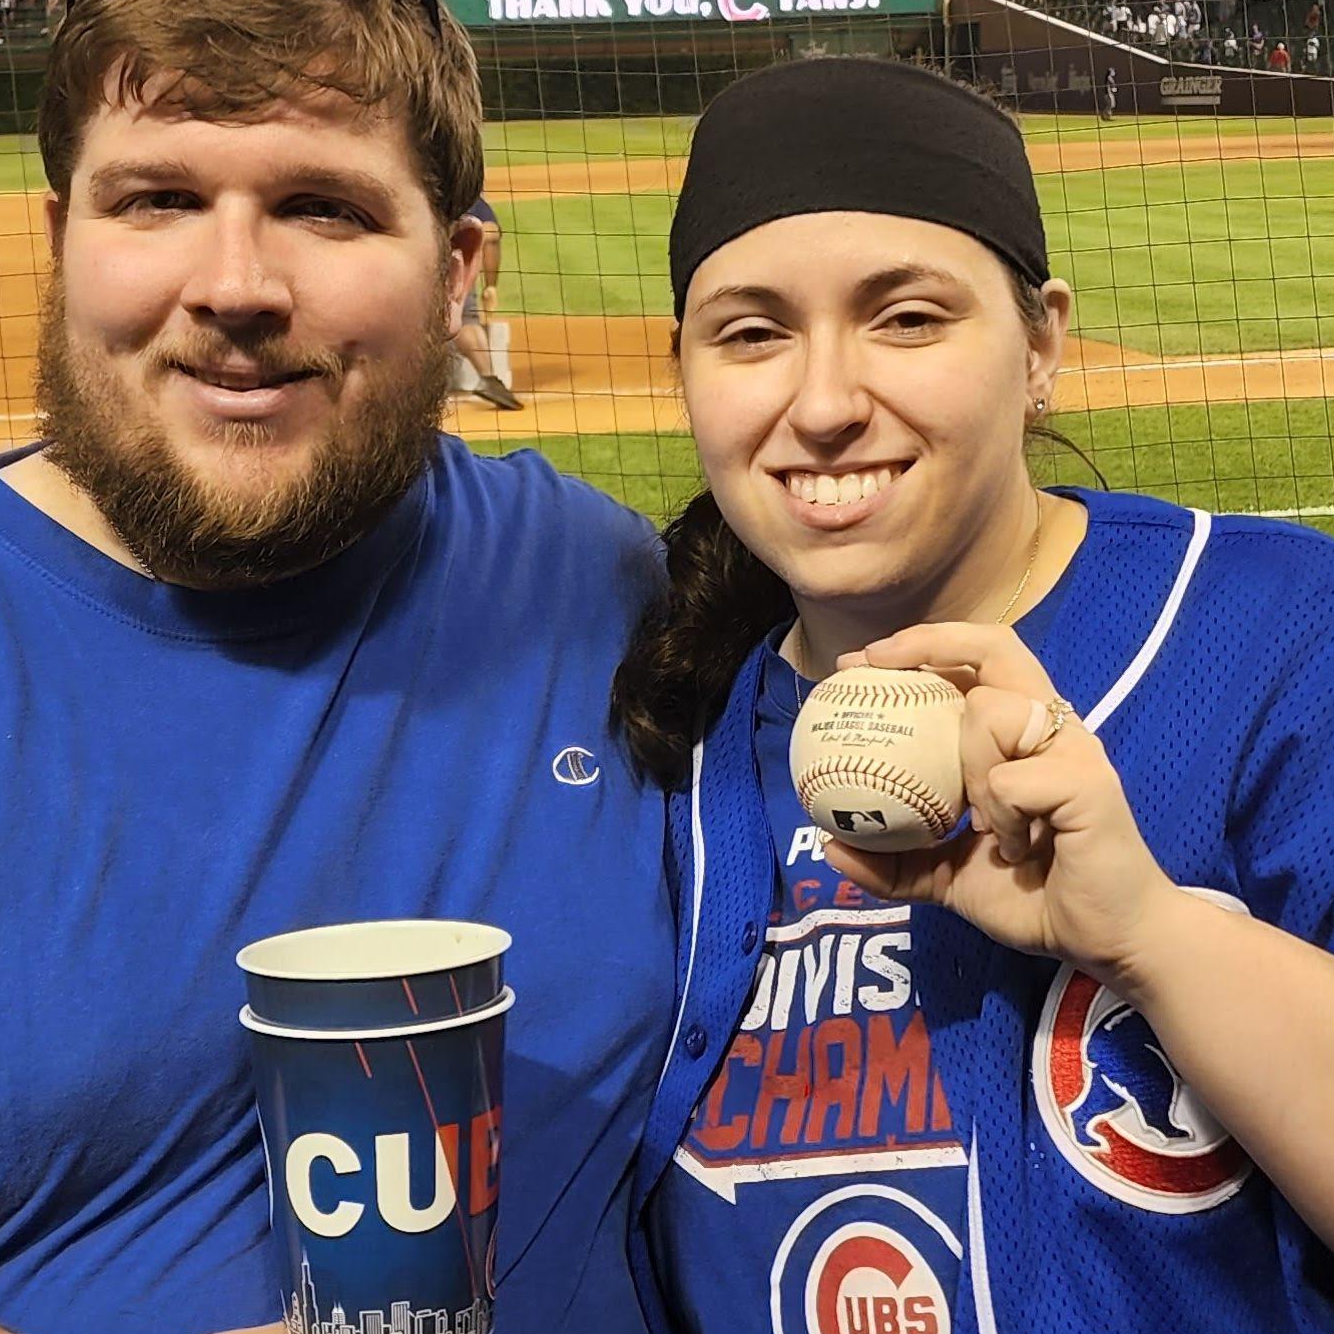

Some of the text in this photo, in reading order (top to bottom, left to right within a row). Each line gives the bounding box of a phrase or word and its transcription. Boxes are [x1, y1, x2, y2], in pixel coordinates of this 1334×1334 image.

[1160, 75, 1223, 95] GRAINGER
[868, 721, 915, 737] BASEBALL
[741, 931, 922, 1031] DIVIS
[694, 1011, 952, 1149] CHAM
